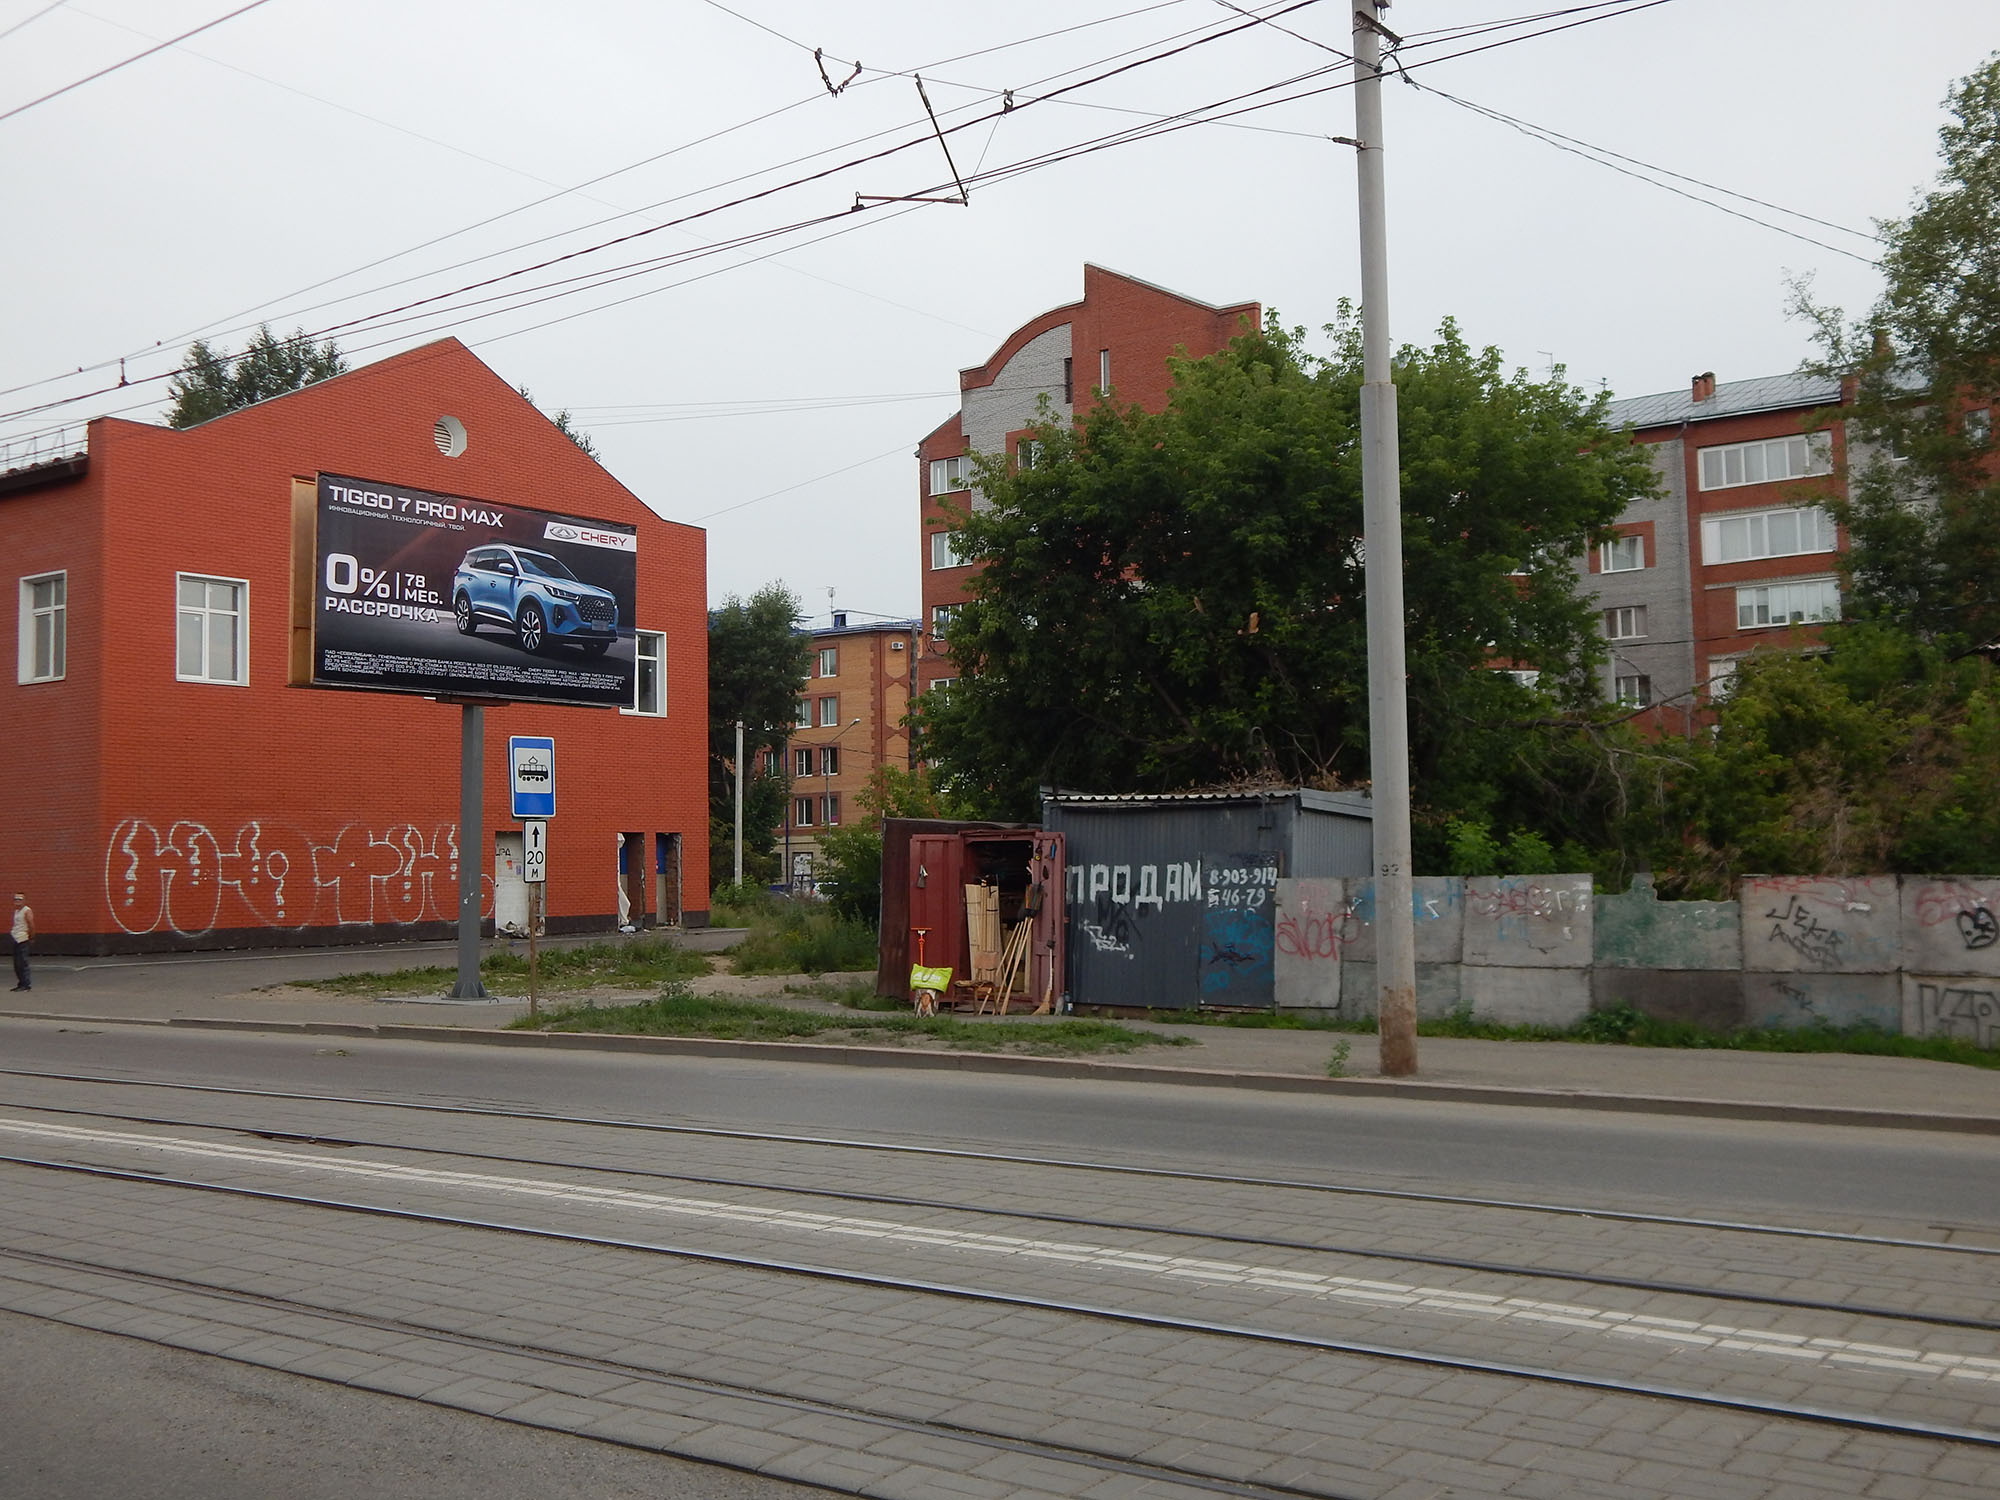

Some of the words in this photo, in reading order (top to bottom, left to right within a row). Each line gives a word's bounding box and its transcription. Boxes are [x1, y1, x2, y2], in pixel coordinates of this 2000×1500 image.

[328, 485, 393, 510] TIGGO
[397, 497, 411, 512] 7
[416, 500, 457, 520] PRO
[461, 507, 504, 528] MAX
[581, 531, 628, 546] CHERY
[326, 552, 391, 598] 0%
[404, 573, 426, 588] 78
[325, 596, 439, 623] РАССРОЧКА
[404, 588, 444, 605] МЕС.
[526, 850, 544, 865] 20
[1066, 860, 1202, 912] ПРОДАМ
